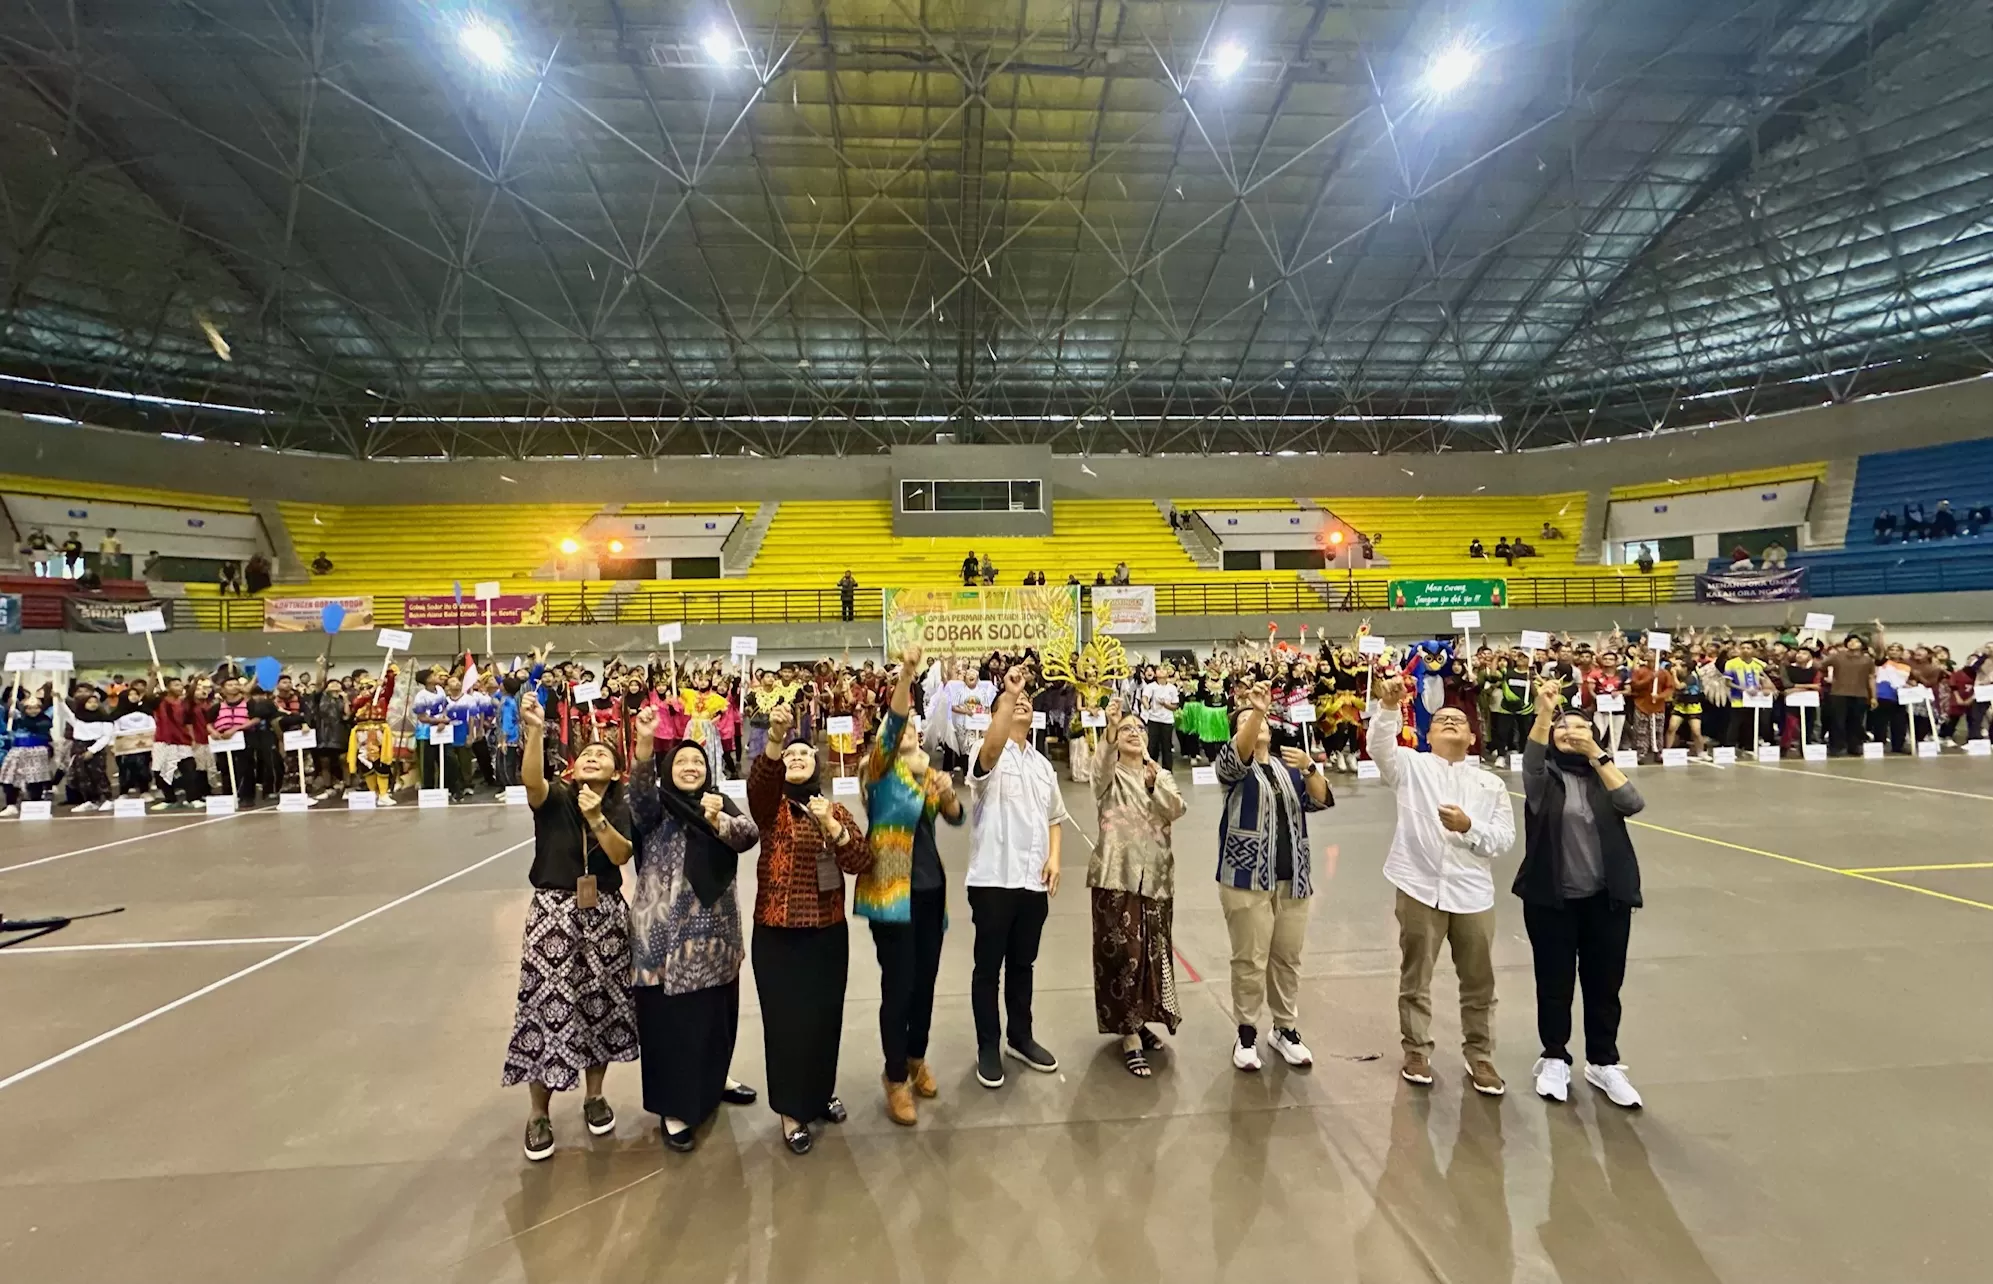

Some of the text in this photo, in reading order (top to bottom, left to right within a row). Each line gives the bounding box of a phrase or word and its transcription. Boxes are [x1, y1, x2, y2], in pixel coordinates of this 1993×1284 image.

[1425, 583, 1441, 593] Main
[1706, 589, 1735, 598] KALAH
[1758, 587, 1800, 596] NGAMUK
[1414, 595, 1439, 606] Jangan
[1440, 596, 1449, 605] ya
[1464, 596, 1472, 605] ya
[952, 614, 996, 622] PERMAINAN
[924, 623, 1047, 641] GOBAK SODOR
